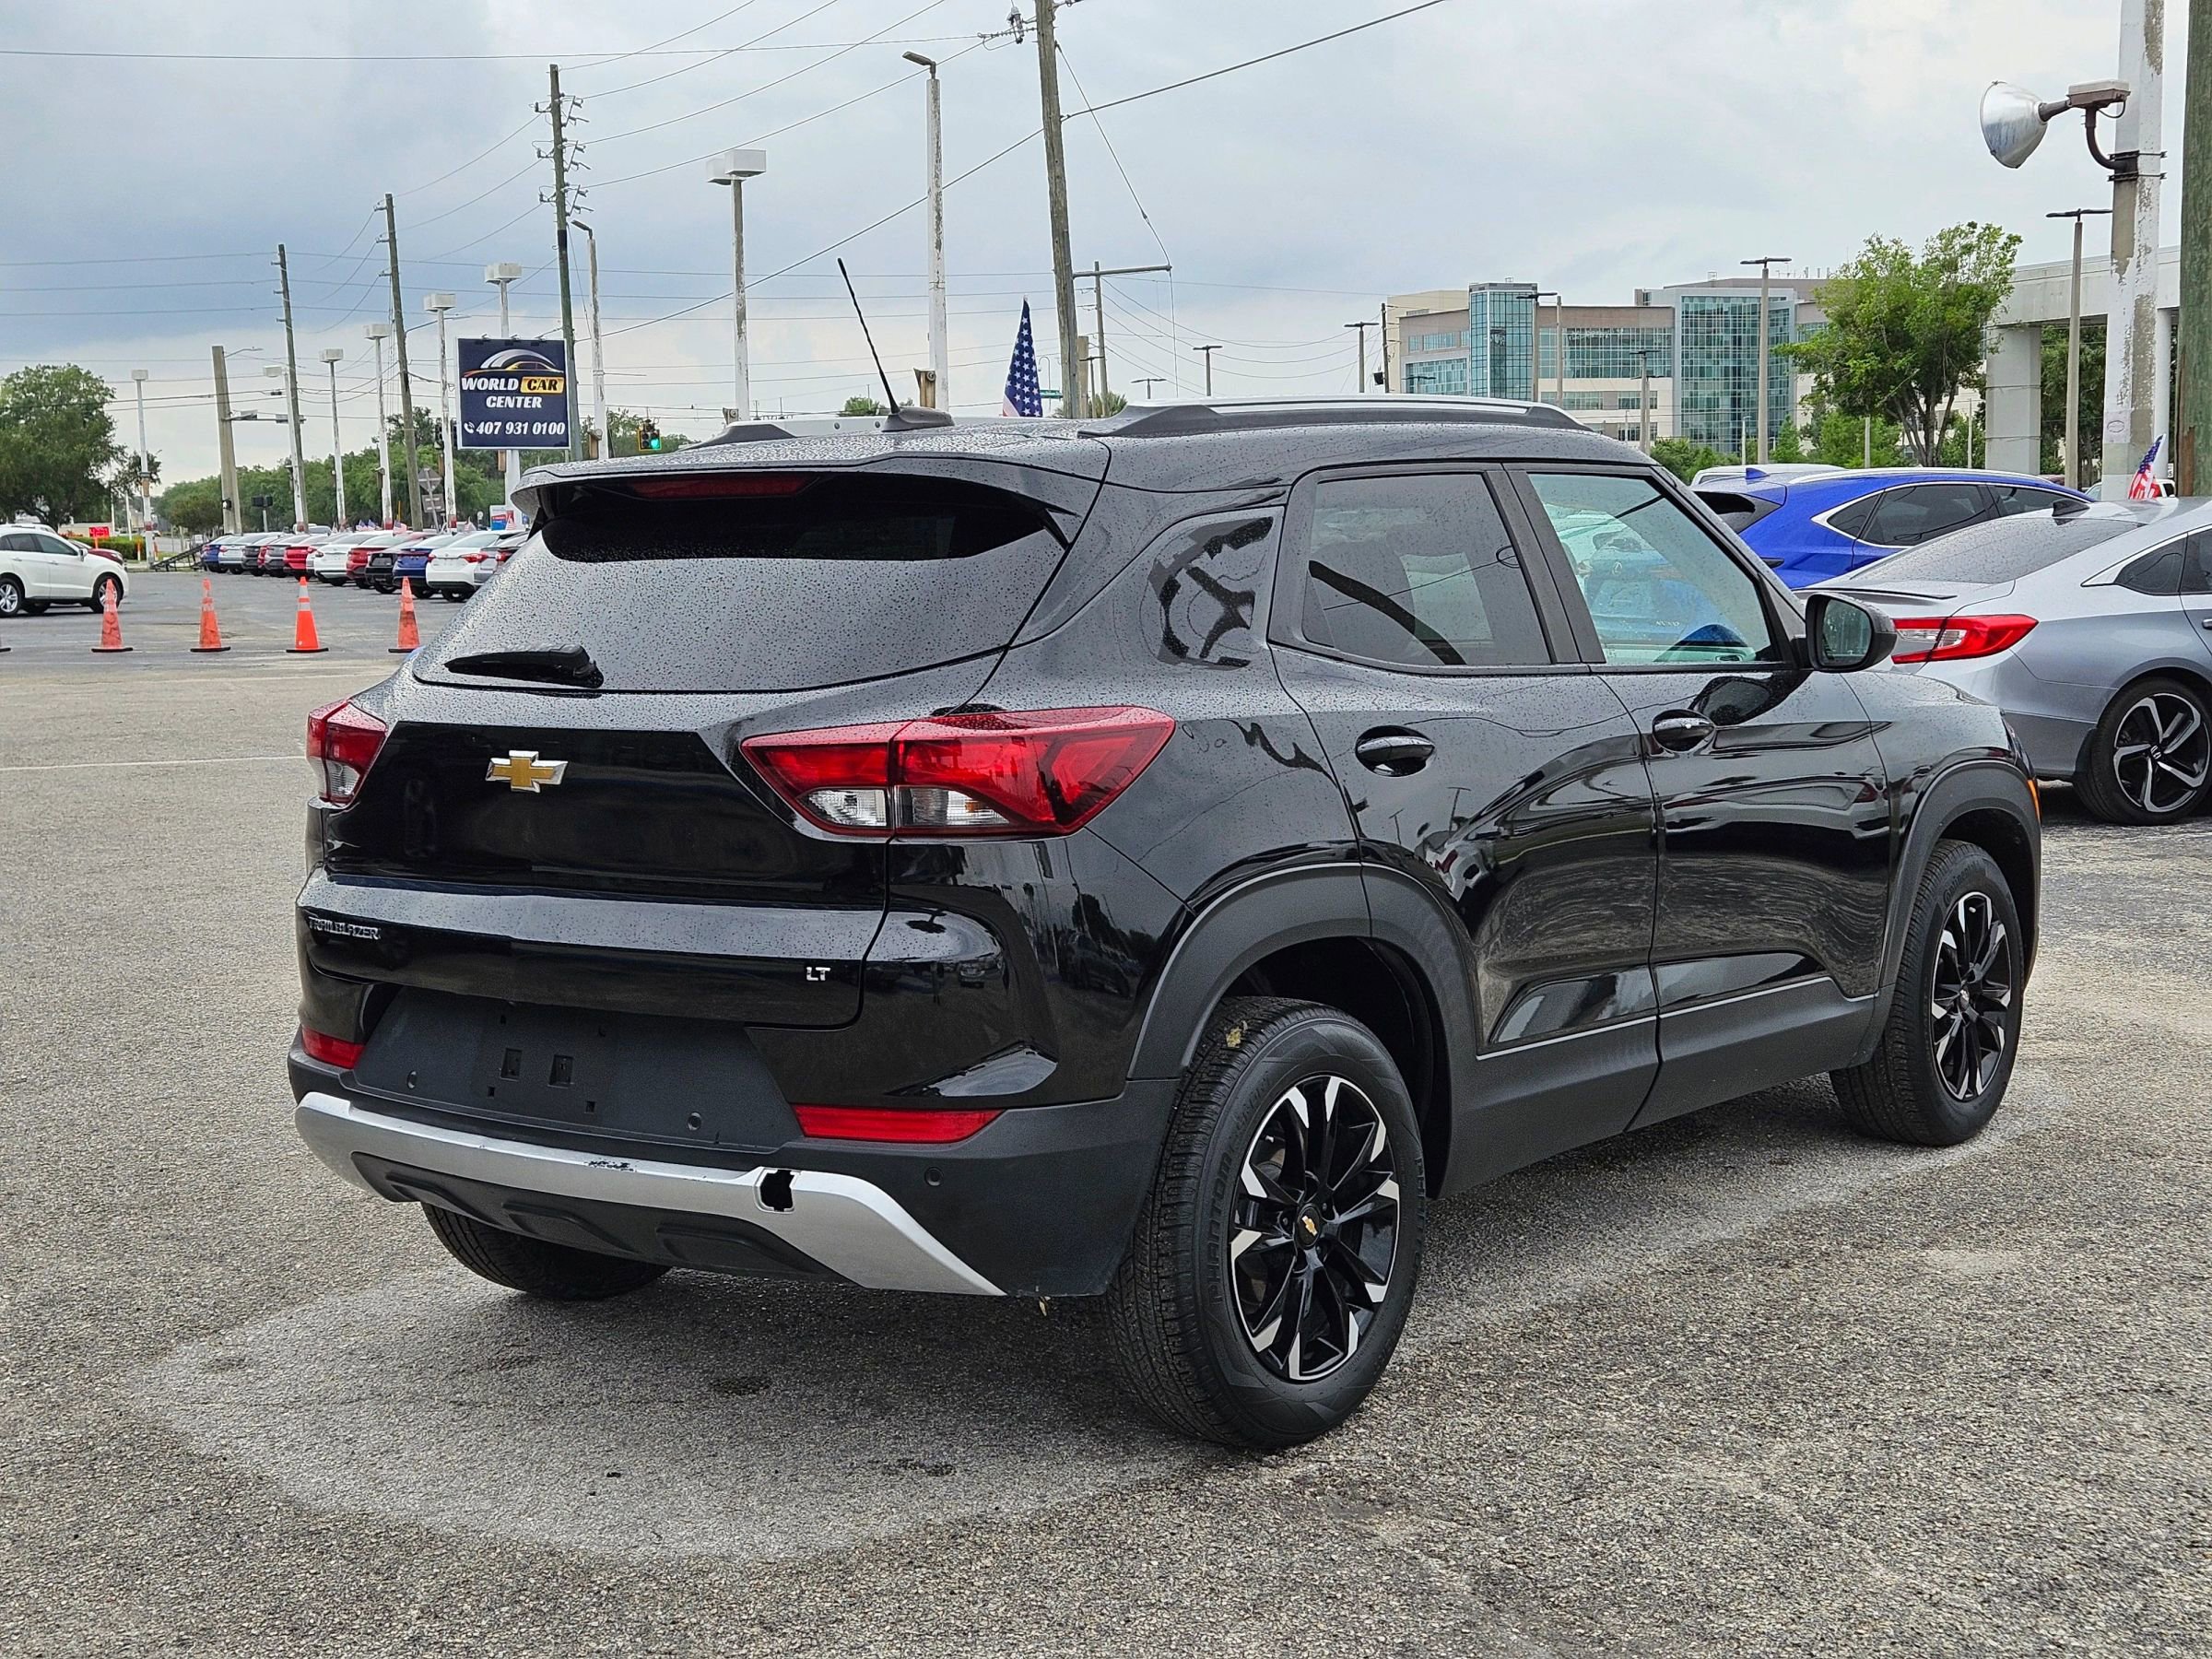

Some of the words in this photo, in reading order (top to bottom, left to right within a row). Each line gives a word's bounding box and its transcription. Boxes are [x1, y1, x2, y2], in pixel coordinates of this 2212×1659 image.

[461, 378, 519, 391] WORLD
[527, 379, 558, 391] CAR
[486, 395, 542, 408] CENTER
[476, 421, 502, 435] 407
[505, 421, 529, 435] 931
[532, 422, 566, 435] 0100
[308, 916, 379, 940] TRAILBLAZER
[806, 966, 831, 982] LT
